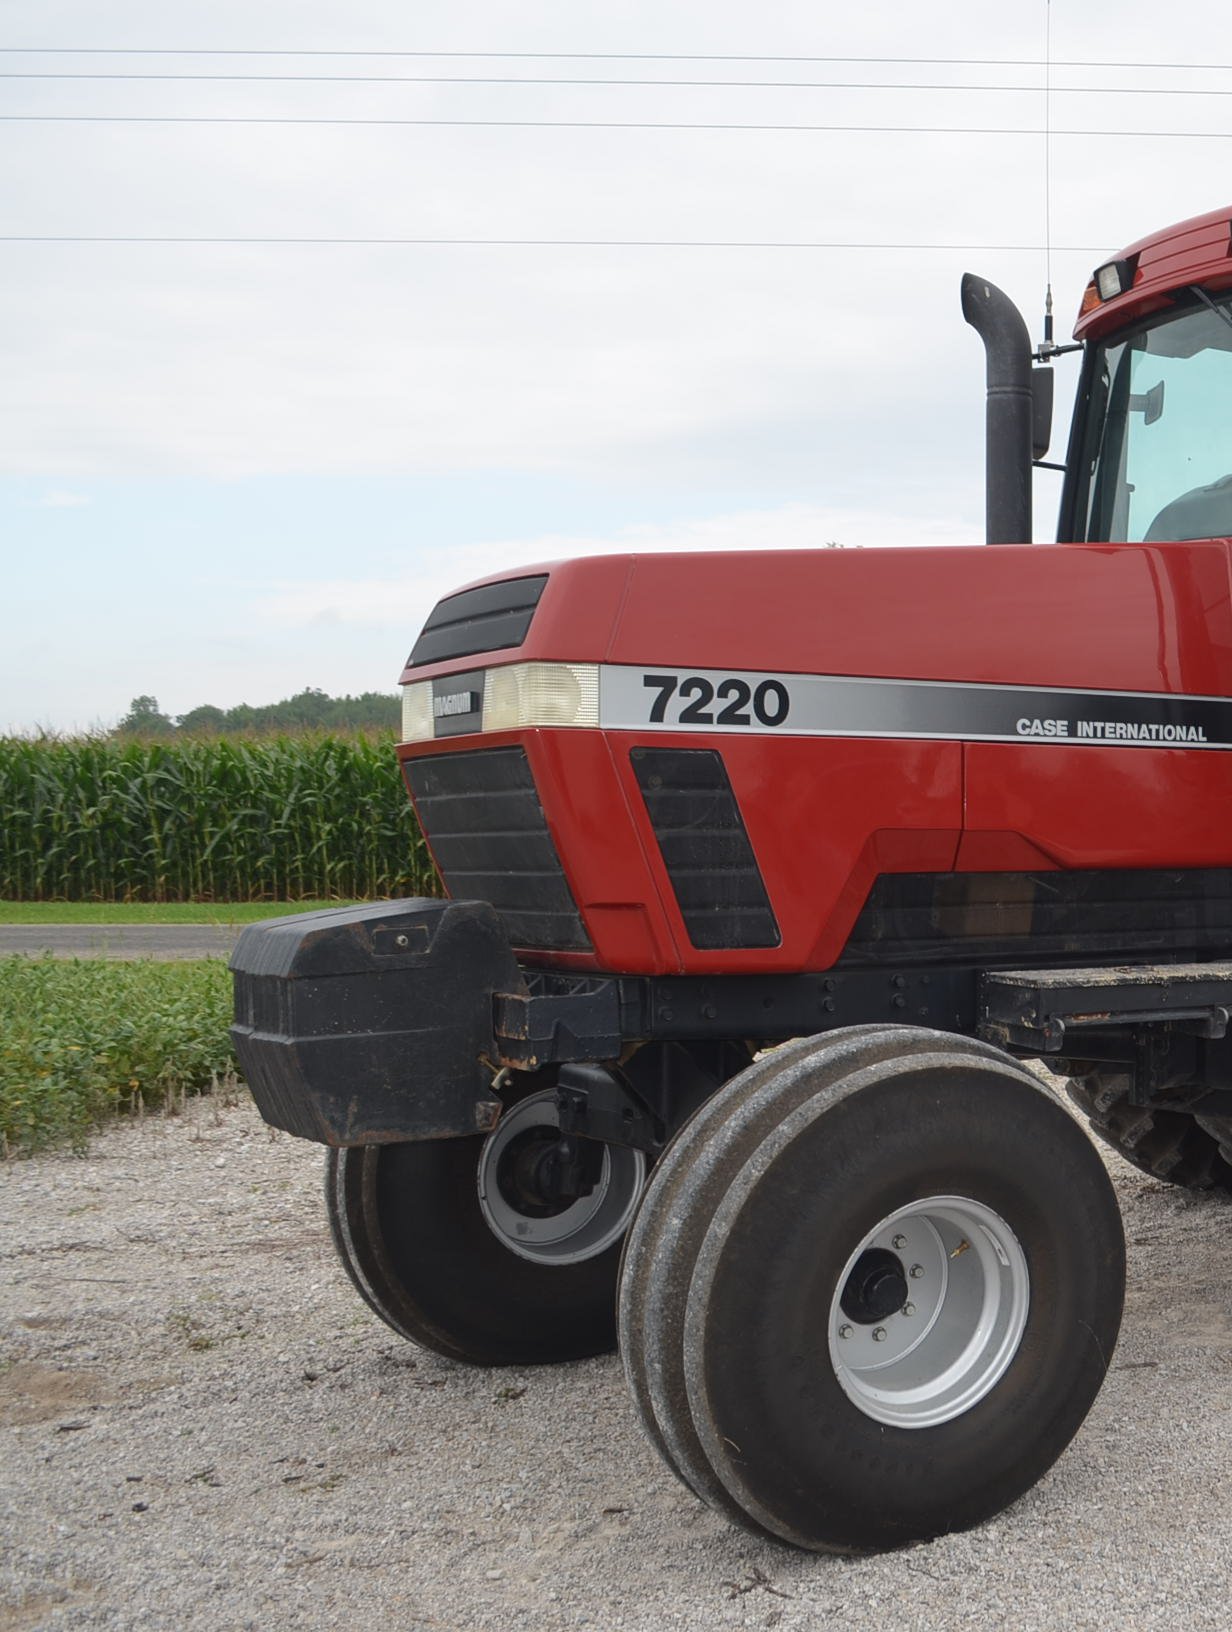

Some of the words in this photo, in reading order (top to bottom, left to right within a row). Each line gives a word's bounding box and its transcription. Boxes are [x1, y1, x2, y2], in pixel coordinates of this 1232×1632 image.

[643, 674, 790, 727] 7220
[1016, 718, 1068, 737] CASE
[1077, 720, 1207, 741] INTERNATIONAL
